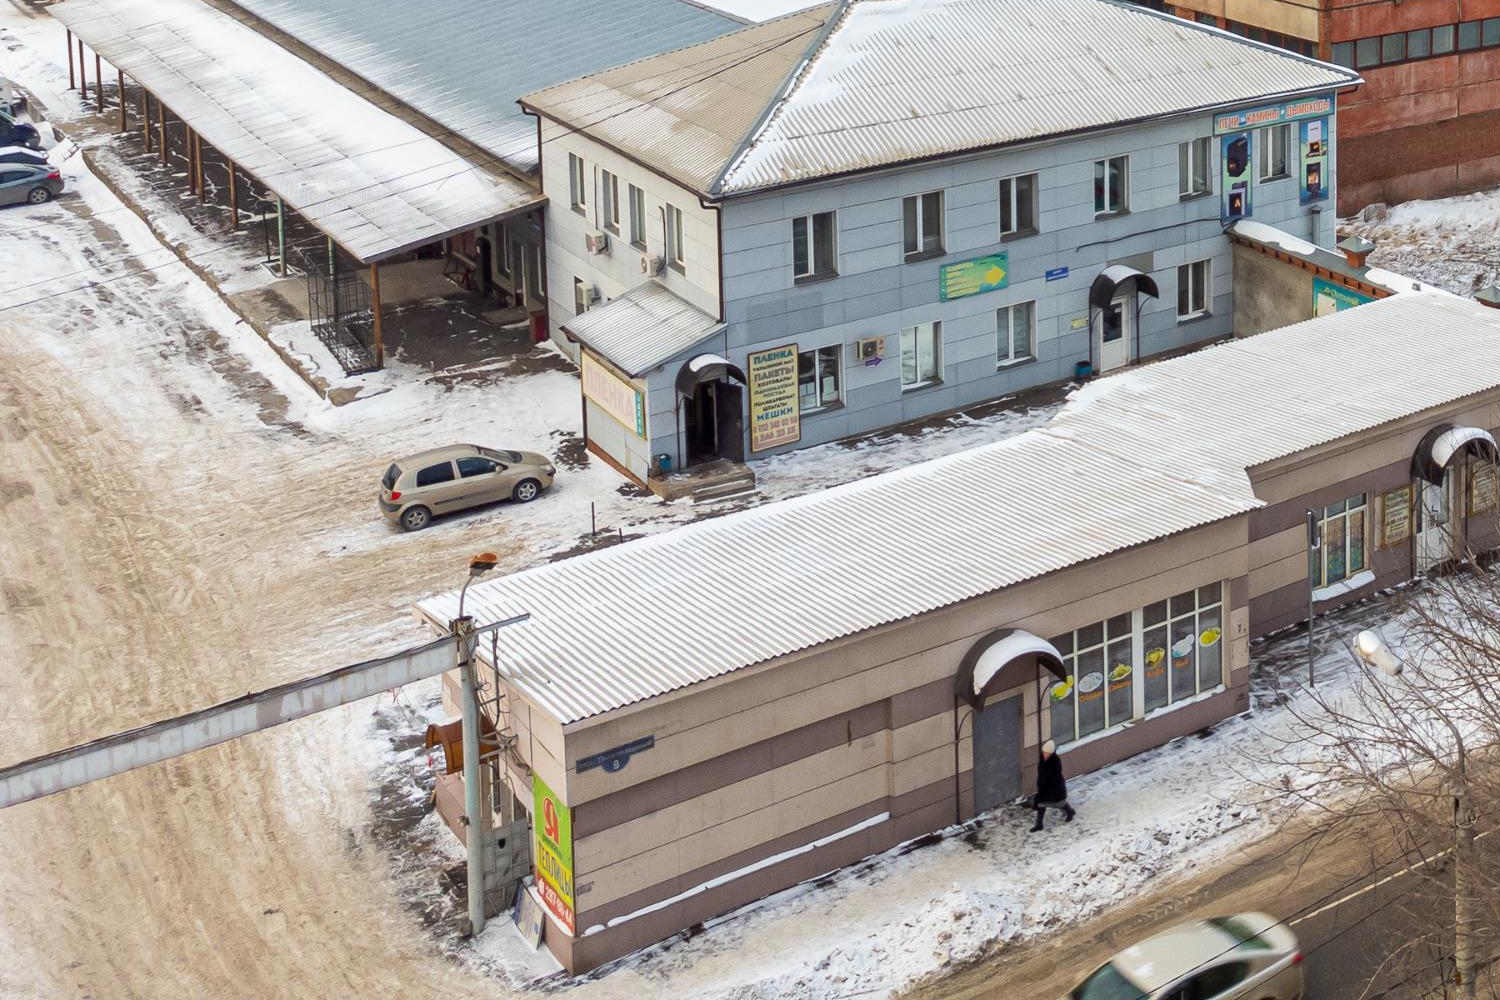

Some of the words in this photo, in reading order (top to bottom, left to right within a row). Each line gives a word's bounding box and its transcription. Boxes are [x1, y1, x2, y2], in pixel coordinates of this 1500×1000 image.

[1218, 115, 1240, 130] ПЕЧИ
[1245, 107, 1281, 124] КАМИНЫ
[1286, 98, 1331, 119] ДЫМОХОДЫ
[753, 348, 794, 365] ПЛЕНКА
[753, 365, 795, 382] ПАКЕТЫ
[757, 375, 792, 388] ХОЗТОВАРЫ
[753, 393, 795, 408] ПОЛИКАРБОНАТ
[756, 406, 793, 422] МЕШКИ
[612, 759, 620, 770] 9
[538, 839, 573, 899] ТЕПЛИЦЫ
